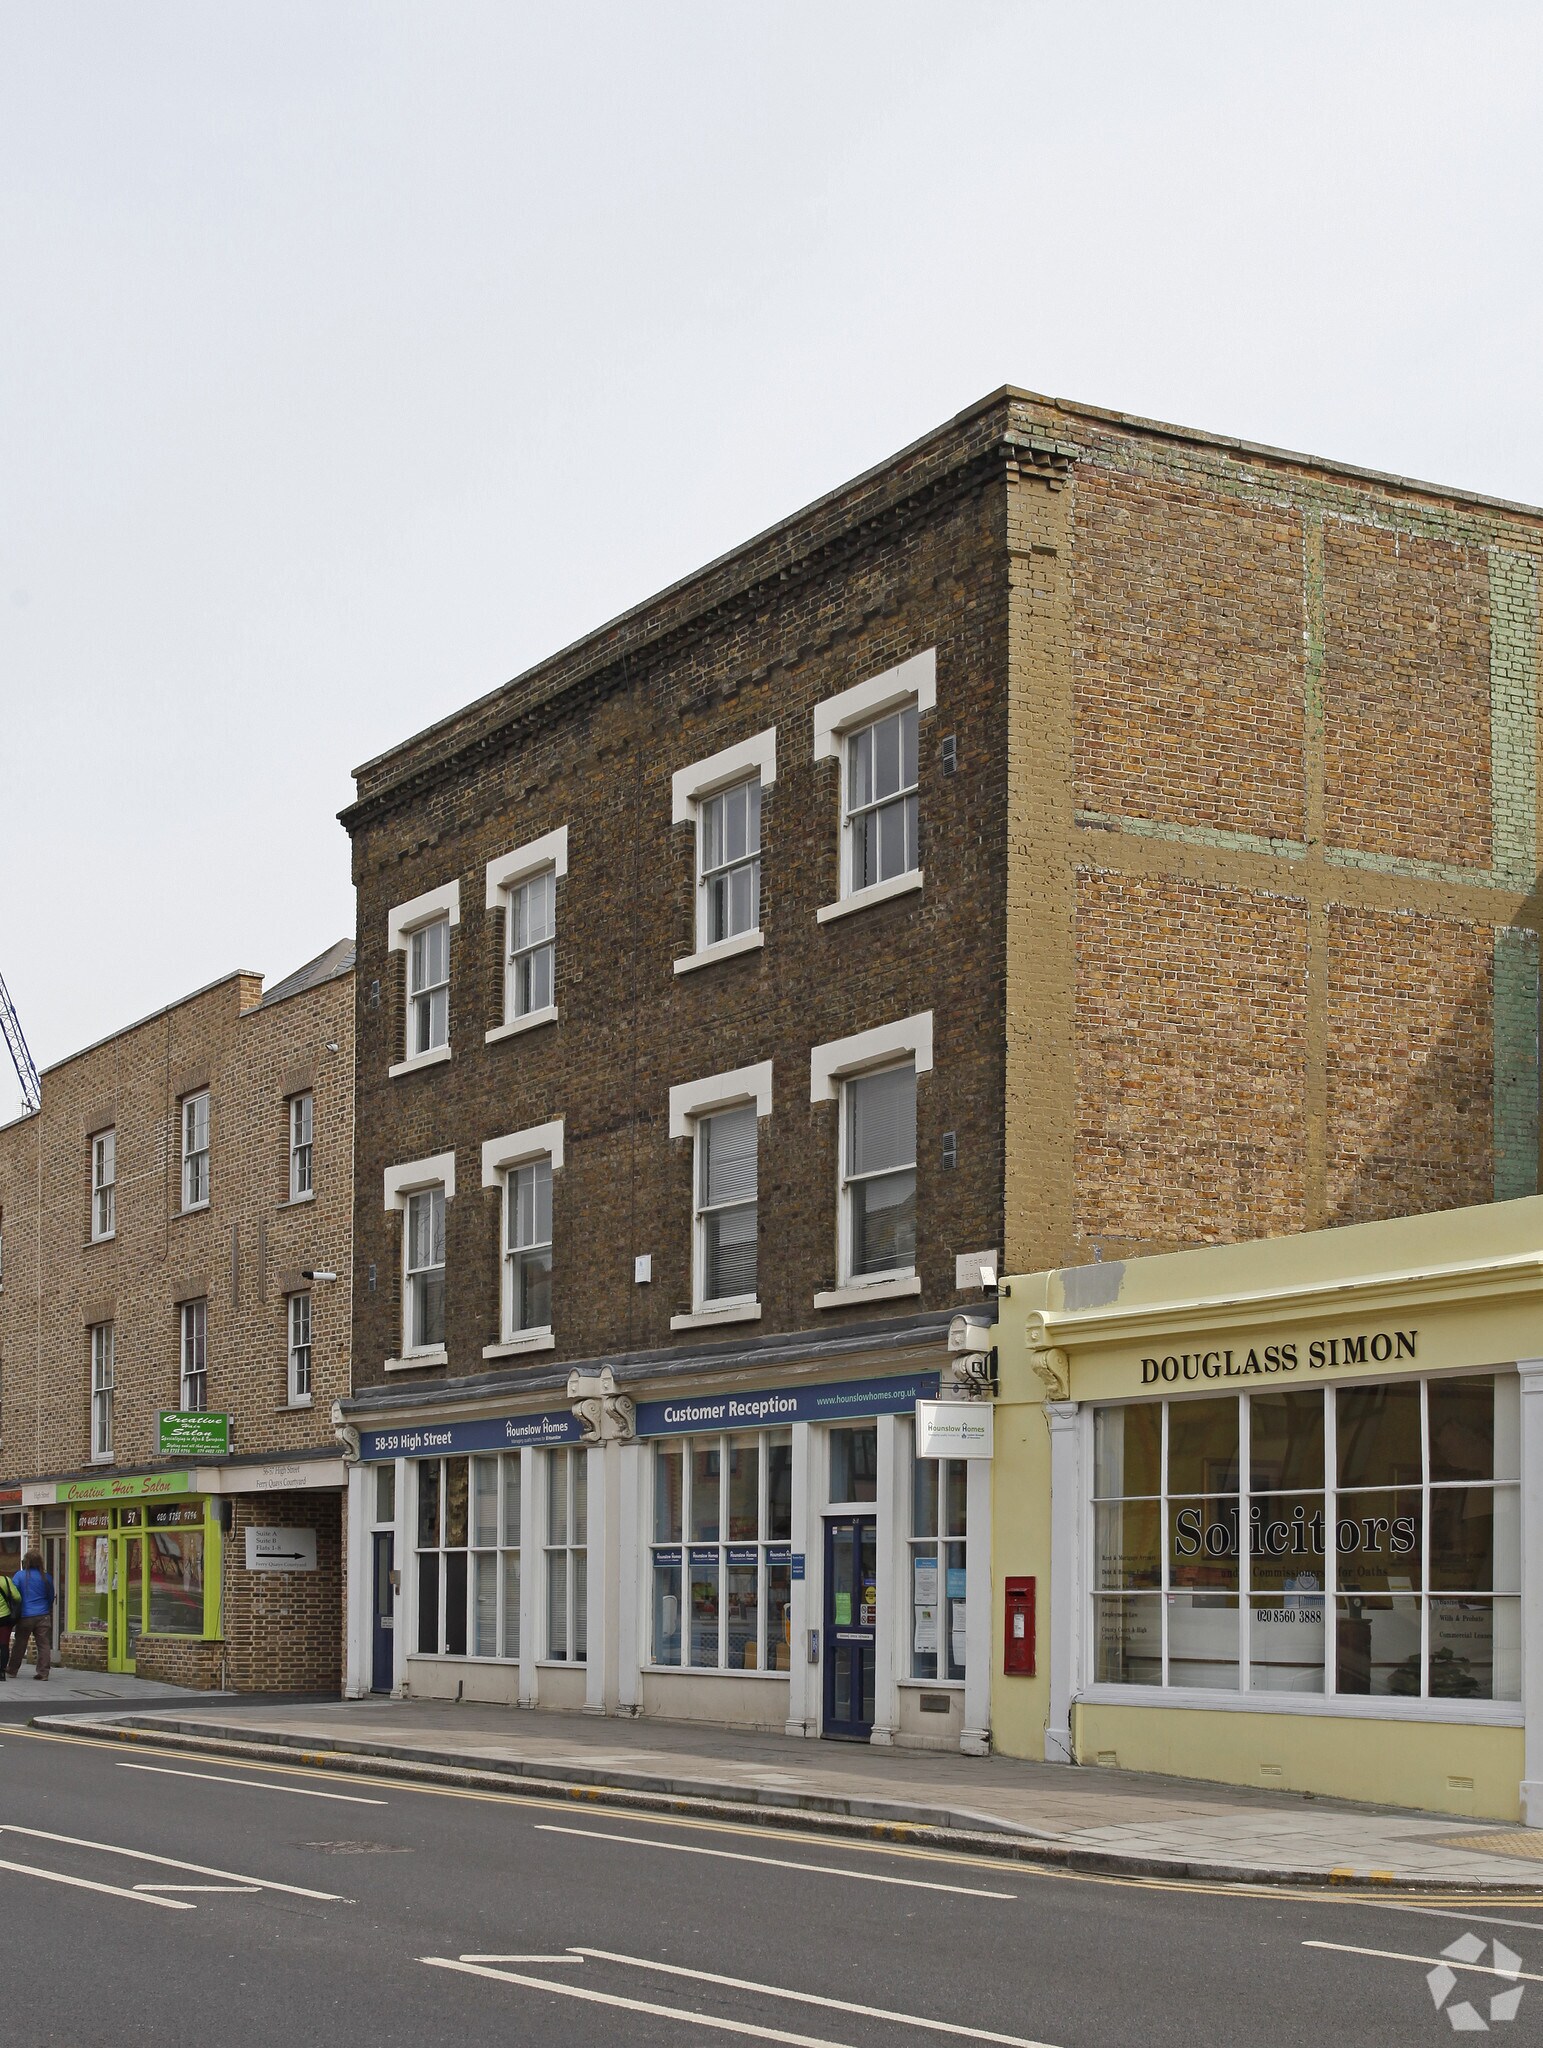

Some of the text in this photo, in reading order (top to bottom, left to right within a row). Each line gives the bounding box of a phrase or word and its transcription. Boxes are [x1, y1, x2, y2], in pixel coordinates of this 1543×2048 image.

[1141, 1330, 1418, 1384] DOUGLASS SIMON
[817, 1388, 916, 1406] www.hounslowhomes.org.uk
[664, 1396, 797, 1423] Customer Reception
[163, 1414, 222, 1424] Creative
[171, 1428, 212, 1436] Salon
[506, 1420, 568, 1437] Hounslow Homes
[928, 1424, 984, 1432] Hounslow Homes
[375, 1432, 452, 1450] 58-59 High Street
[275, 1466, 286, 1476] High
[287, 1466, 300, 1474] Street
[67, 1478, 171, 1500] Creative Hair Salon
[256, 1477, 306, 1490] Ferry Quays Courtyard
[87, 1516, 98, 1526] 4422
[128, 1512, 136, 1523] 57
[156, 1513, 166, 1522] 020
[184, 1511, 197, 1520] 9796
[1176, 1506, 1416, 1556] Solicitors
[1221, 1566, 1388, 1578] and Commissioners for Oaths
[1257, 1610, 1322, 1623] 020 8560 3888
